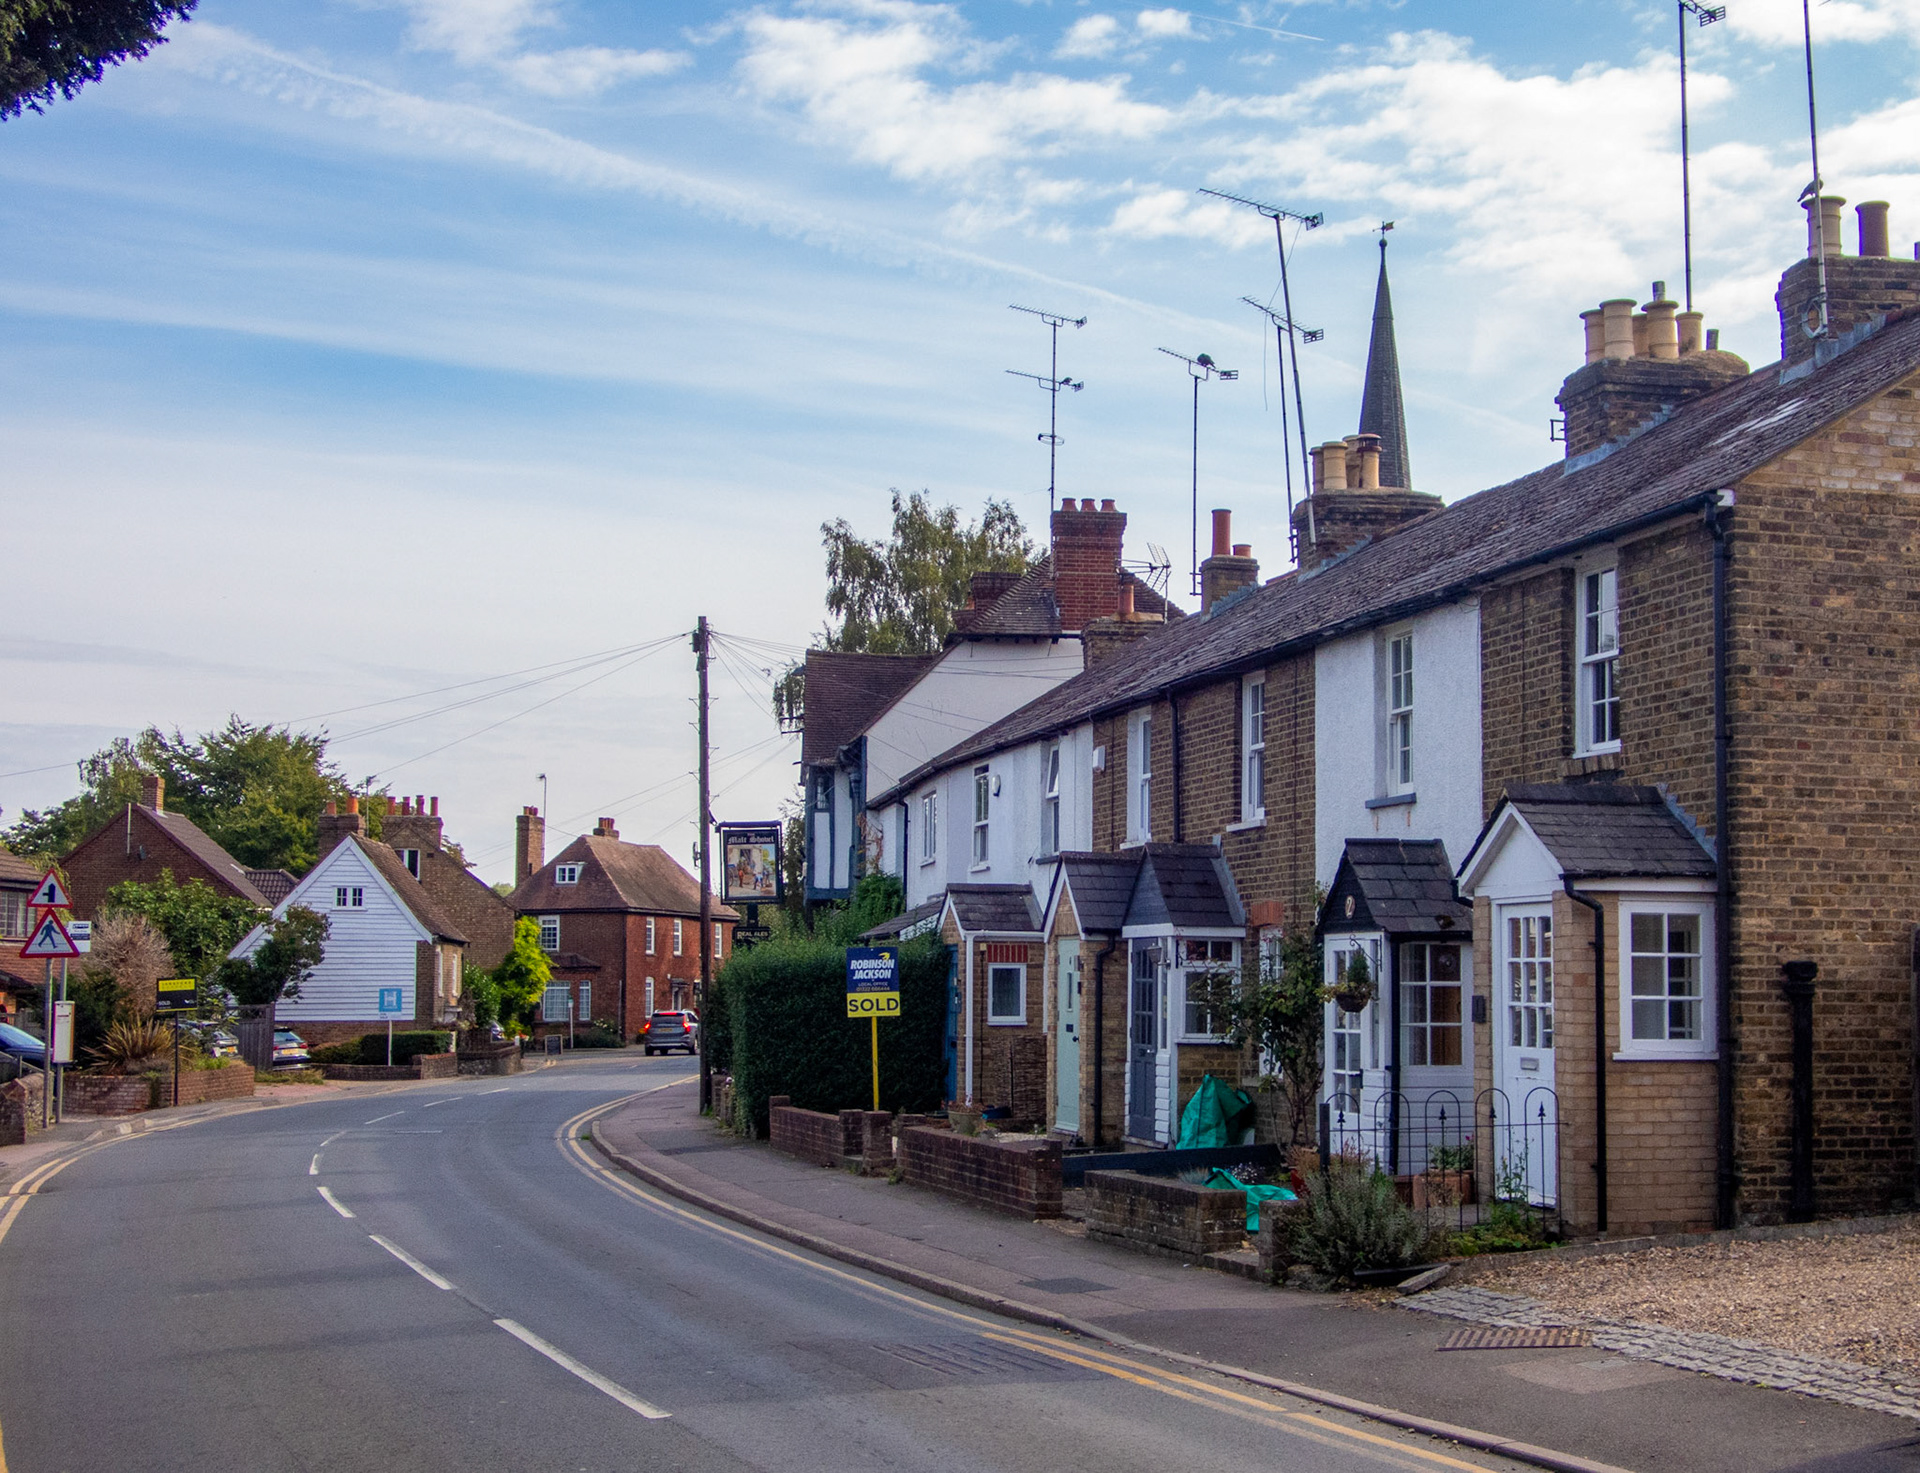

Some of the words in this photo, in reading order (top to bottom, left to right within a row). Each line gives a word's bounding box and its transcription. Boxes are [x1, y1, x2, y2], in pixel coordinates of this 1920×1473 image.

[736, 931, 753, 939] REAL
[850, 959, 895, 970] ROBINSON
[852, 969, 892, 979] JACKSON
[849, 998, 899, 1012] SOLD
